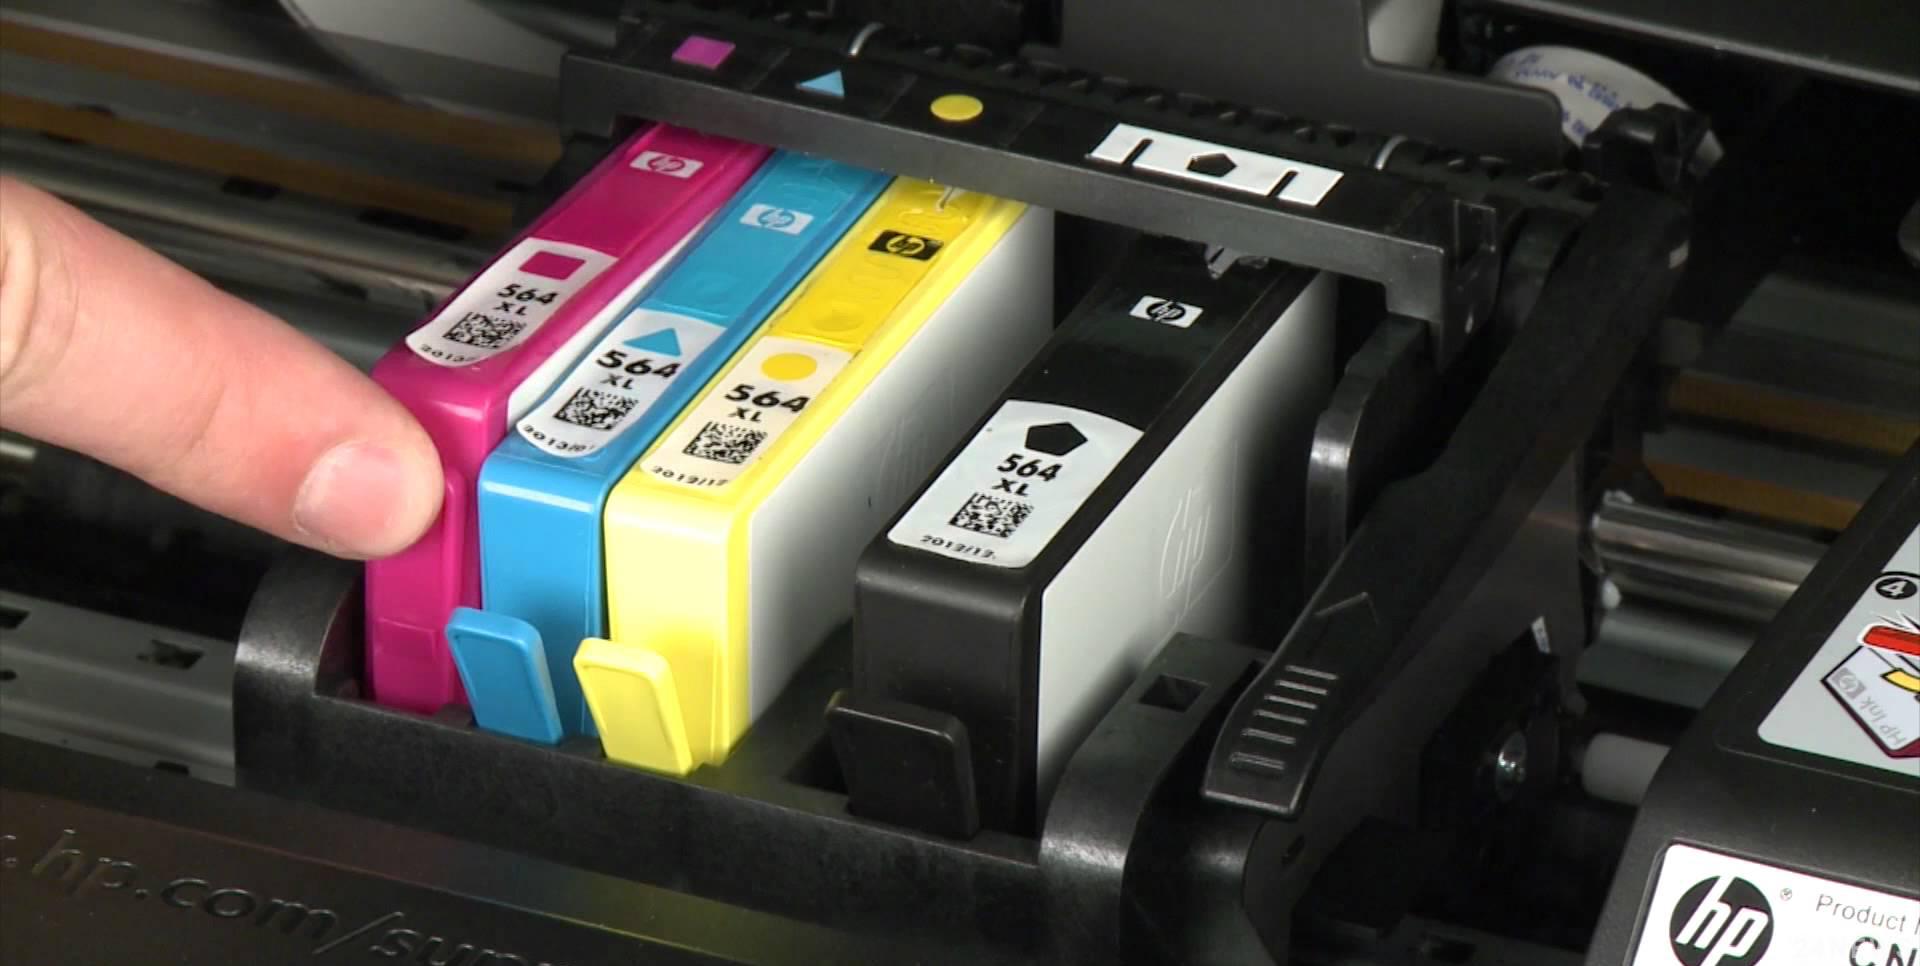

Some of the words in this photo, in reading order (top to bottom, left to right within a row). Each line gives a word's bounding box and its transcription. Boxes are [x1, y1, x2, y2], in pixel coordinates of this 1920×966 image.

[497, 284, 558, 305] 564
[494, 301, 527, 316] XL
[596, 350, 681, 378] 564
[600, 373, 634, 390] XL
[724, 383, 810, 412] 564
[728, 407, 763, 422] XL
[997, 453, 1063, 481] 564
[992, 477, 1031, 496] XL
[1879, 579, 1911, 598] 4
[1671, 875, 1772, 966] hp
[1815, 893, 1907, 932] Product
